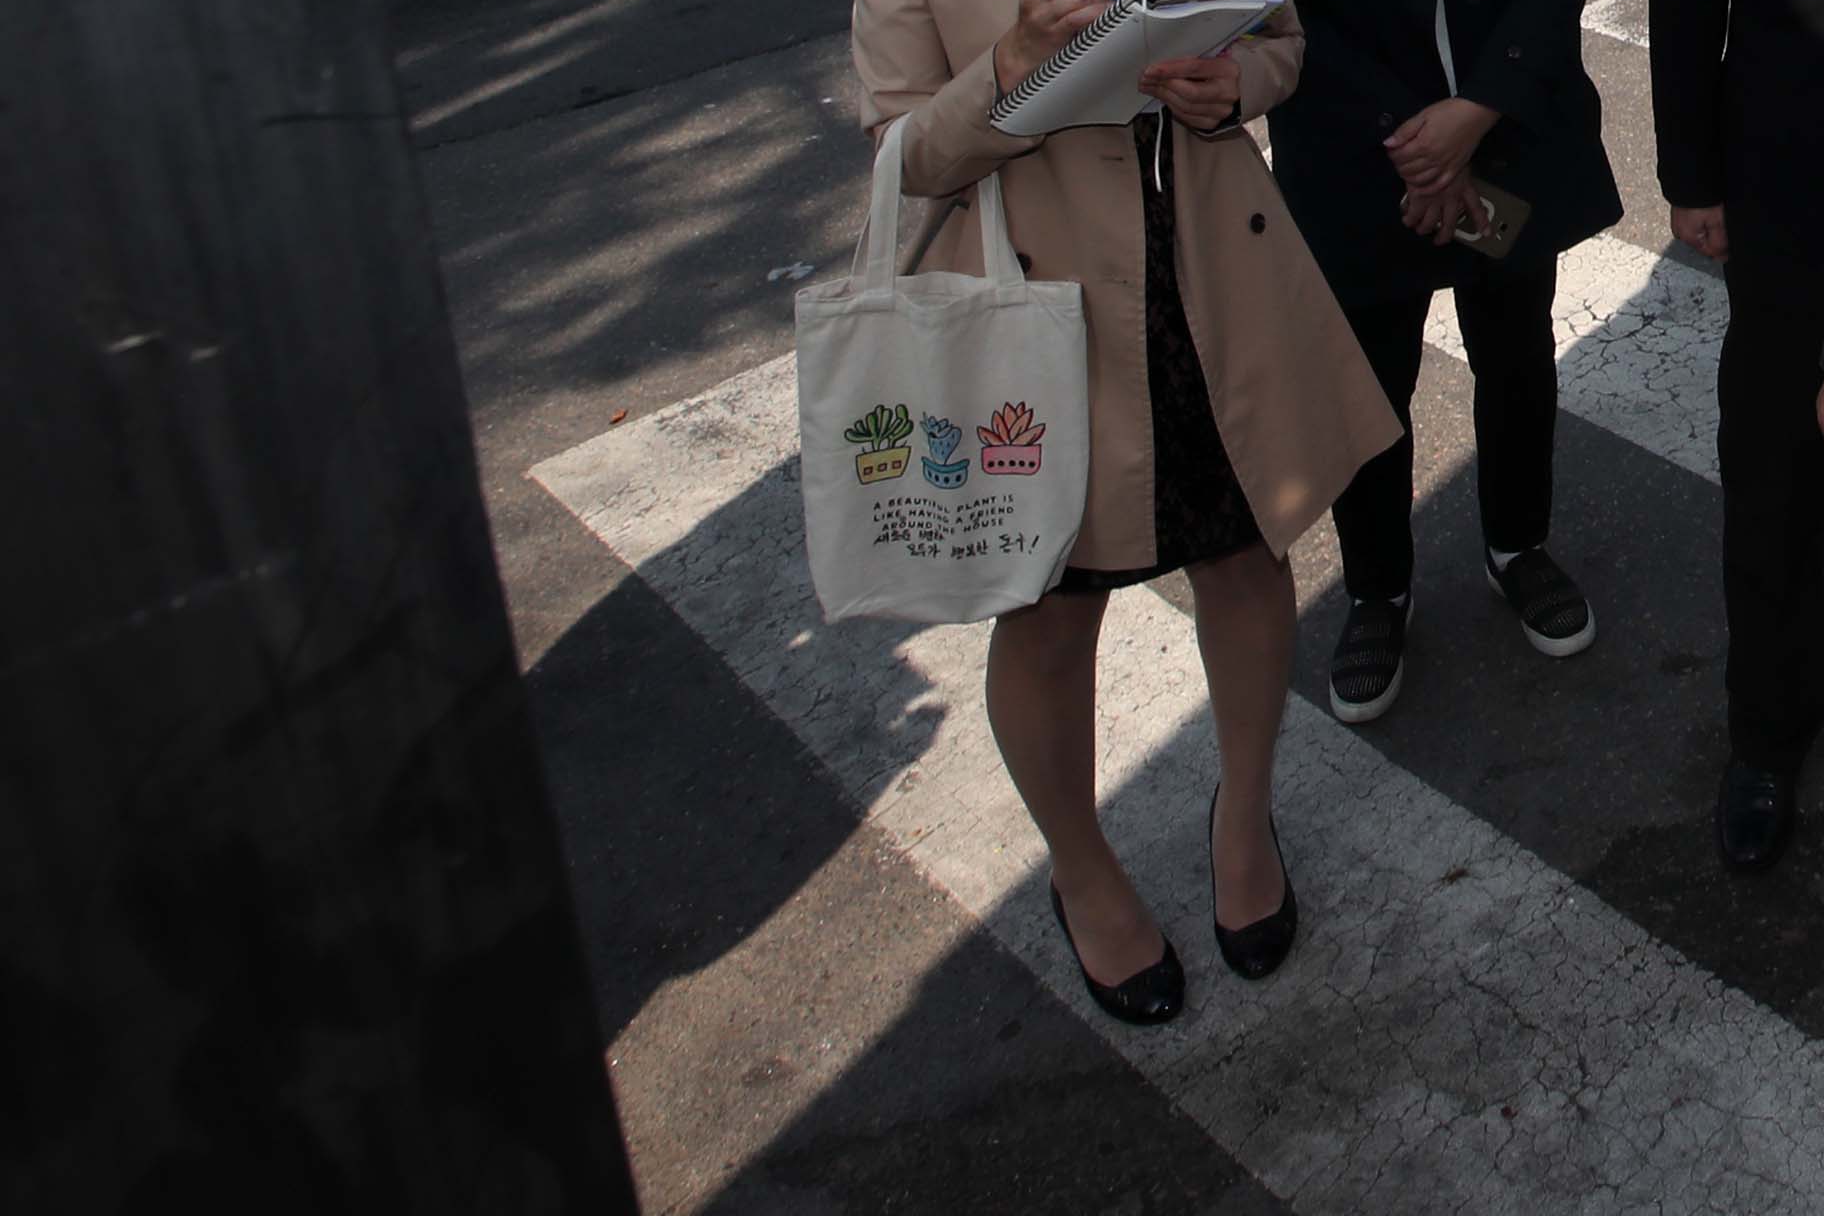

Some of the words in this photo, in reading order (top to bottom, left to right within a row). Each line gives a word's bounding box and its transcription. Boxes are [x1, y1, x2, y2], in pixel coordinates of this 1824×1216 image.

[873, 501, 881, 511] A
[888, 497, 950, 514] BEAUTIFUL
[956, 495, 997, 514] PLANT
[1003, 494, 1014, 503] IS
[873, 510, 900, 523] LIKE
[908, 509, 950, 524] HAVING
[955, 516, 963, 524] A
[969, 506, 1015, 521] FRIEND
[882, 518, 933, 532] AROUND
[963, 518, 1004, 533] HOUSE
